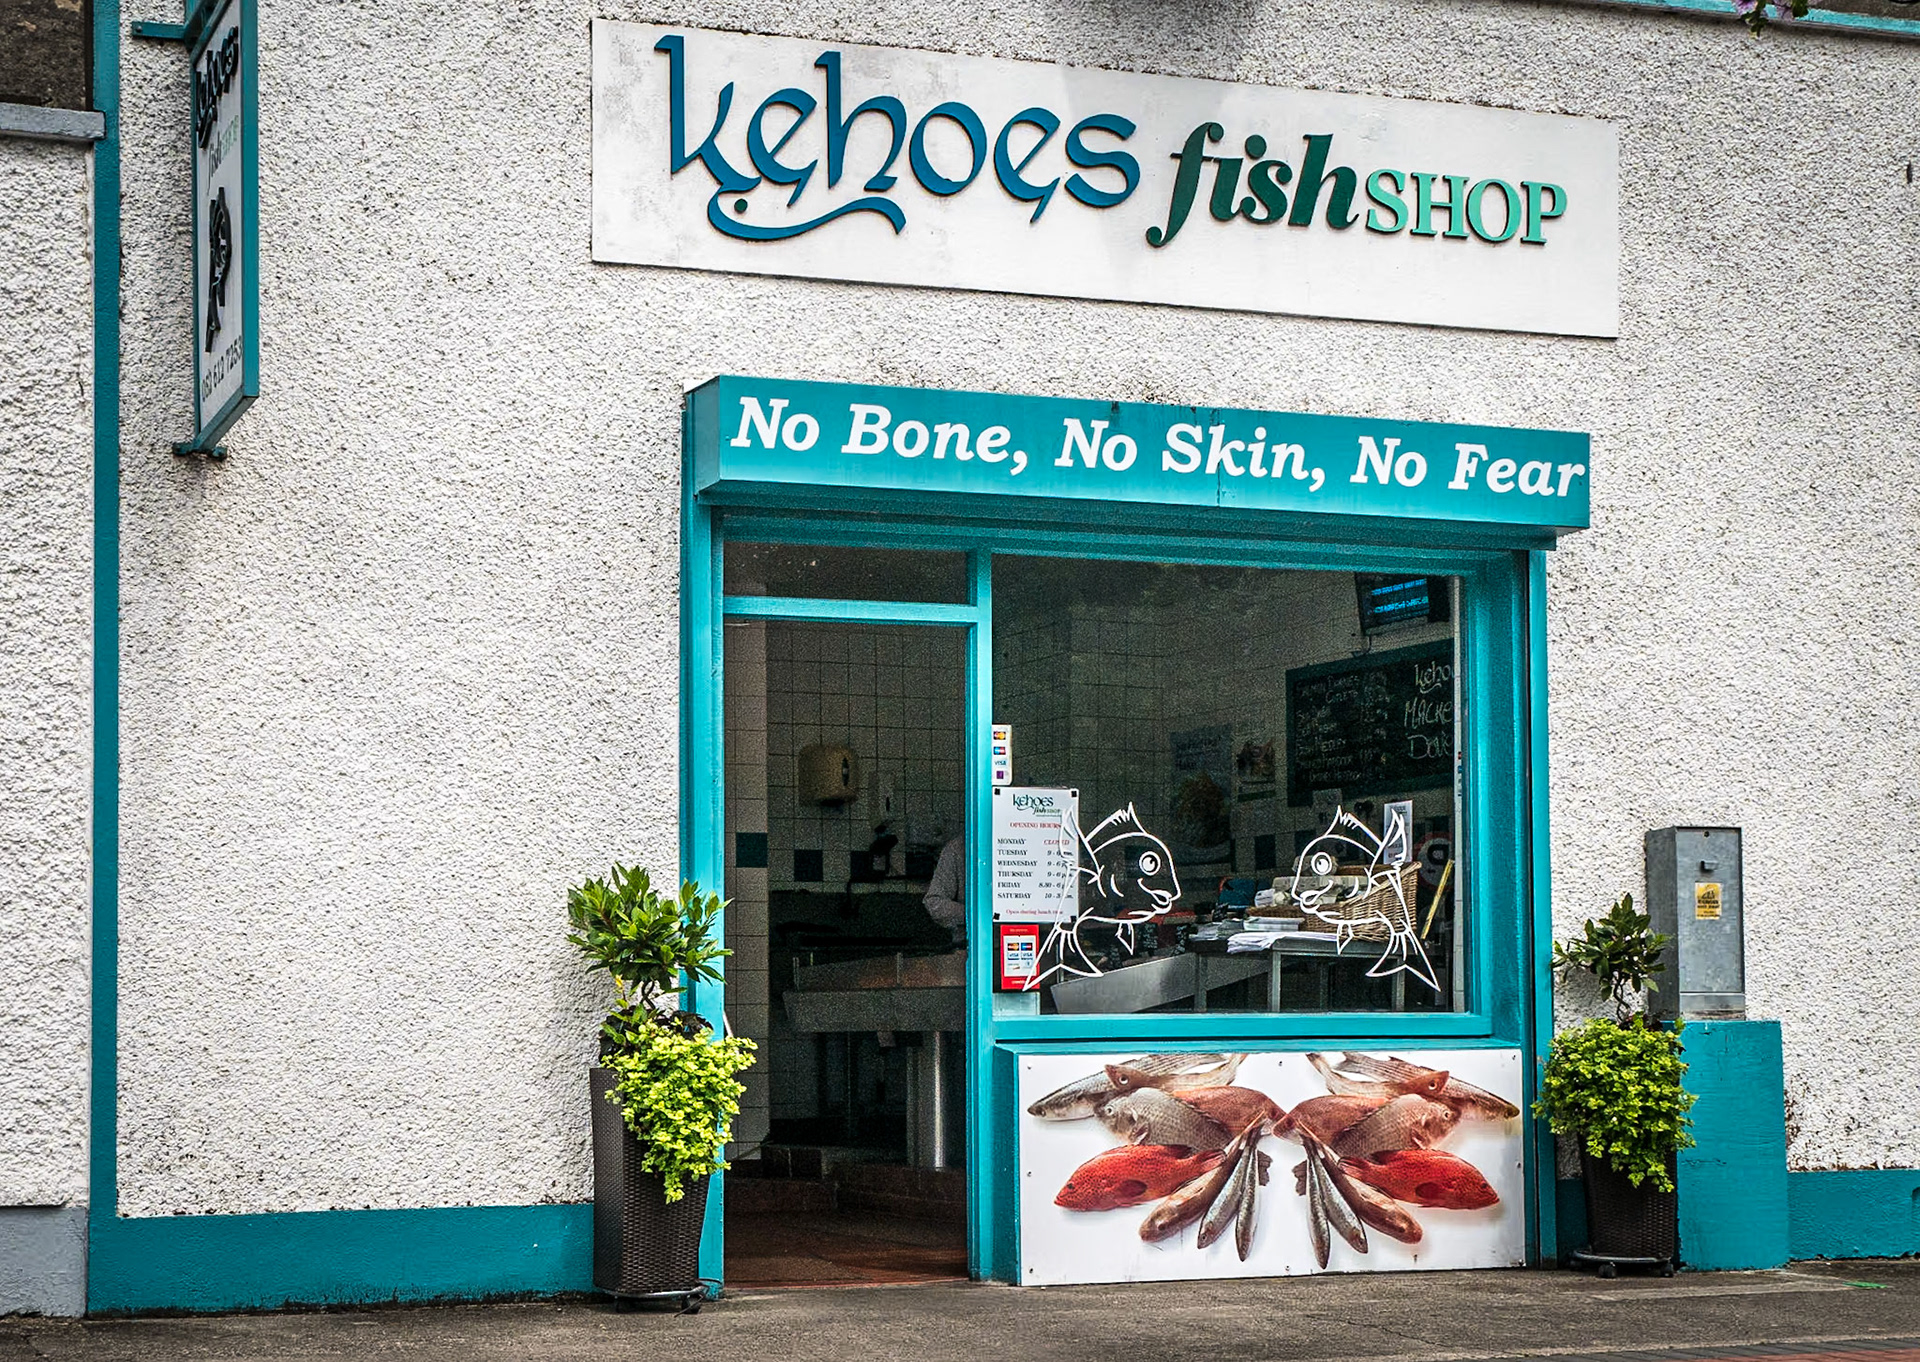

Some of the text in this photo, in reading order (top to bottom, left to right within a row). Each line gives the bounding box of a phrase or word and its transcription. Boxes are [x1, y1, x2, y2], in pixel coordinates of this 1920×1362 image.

[654, 34, 1568, 247] kehoes fish SHOP
[729, 395, 1587, 498] No Bone, No Skin, No Fear
[1013, 793, 1054, 811] kehoes
